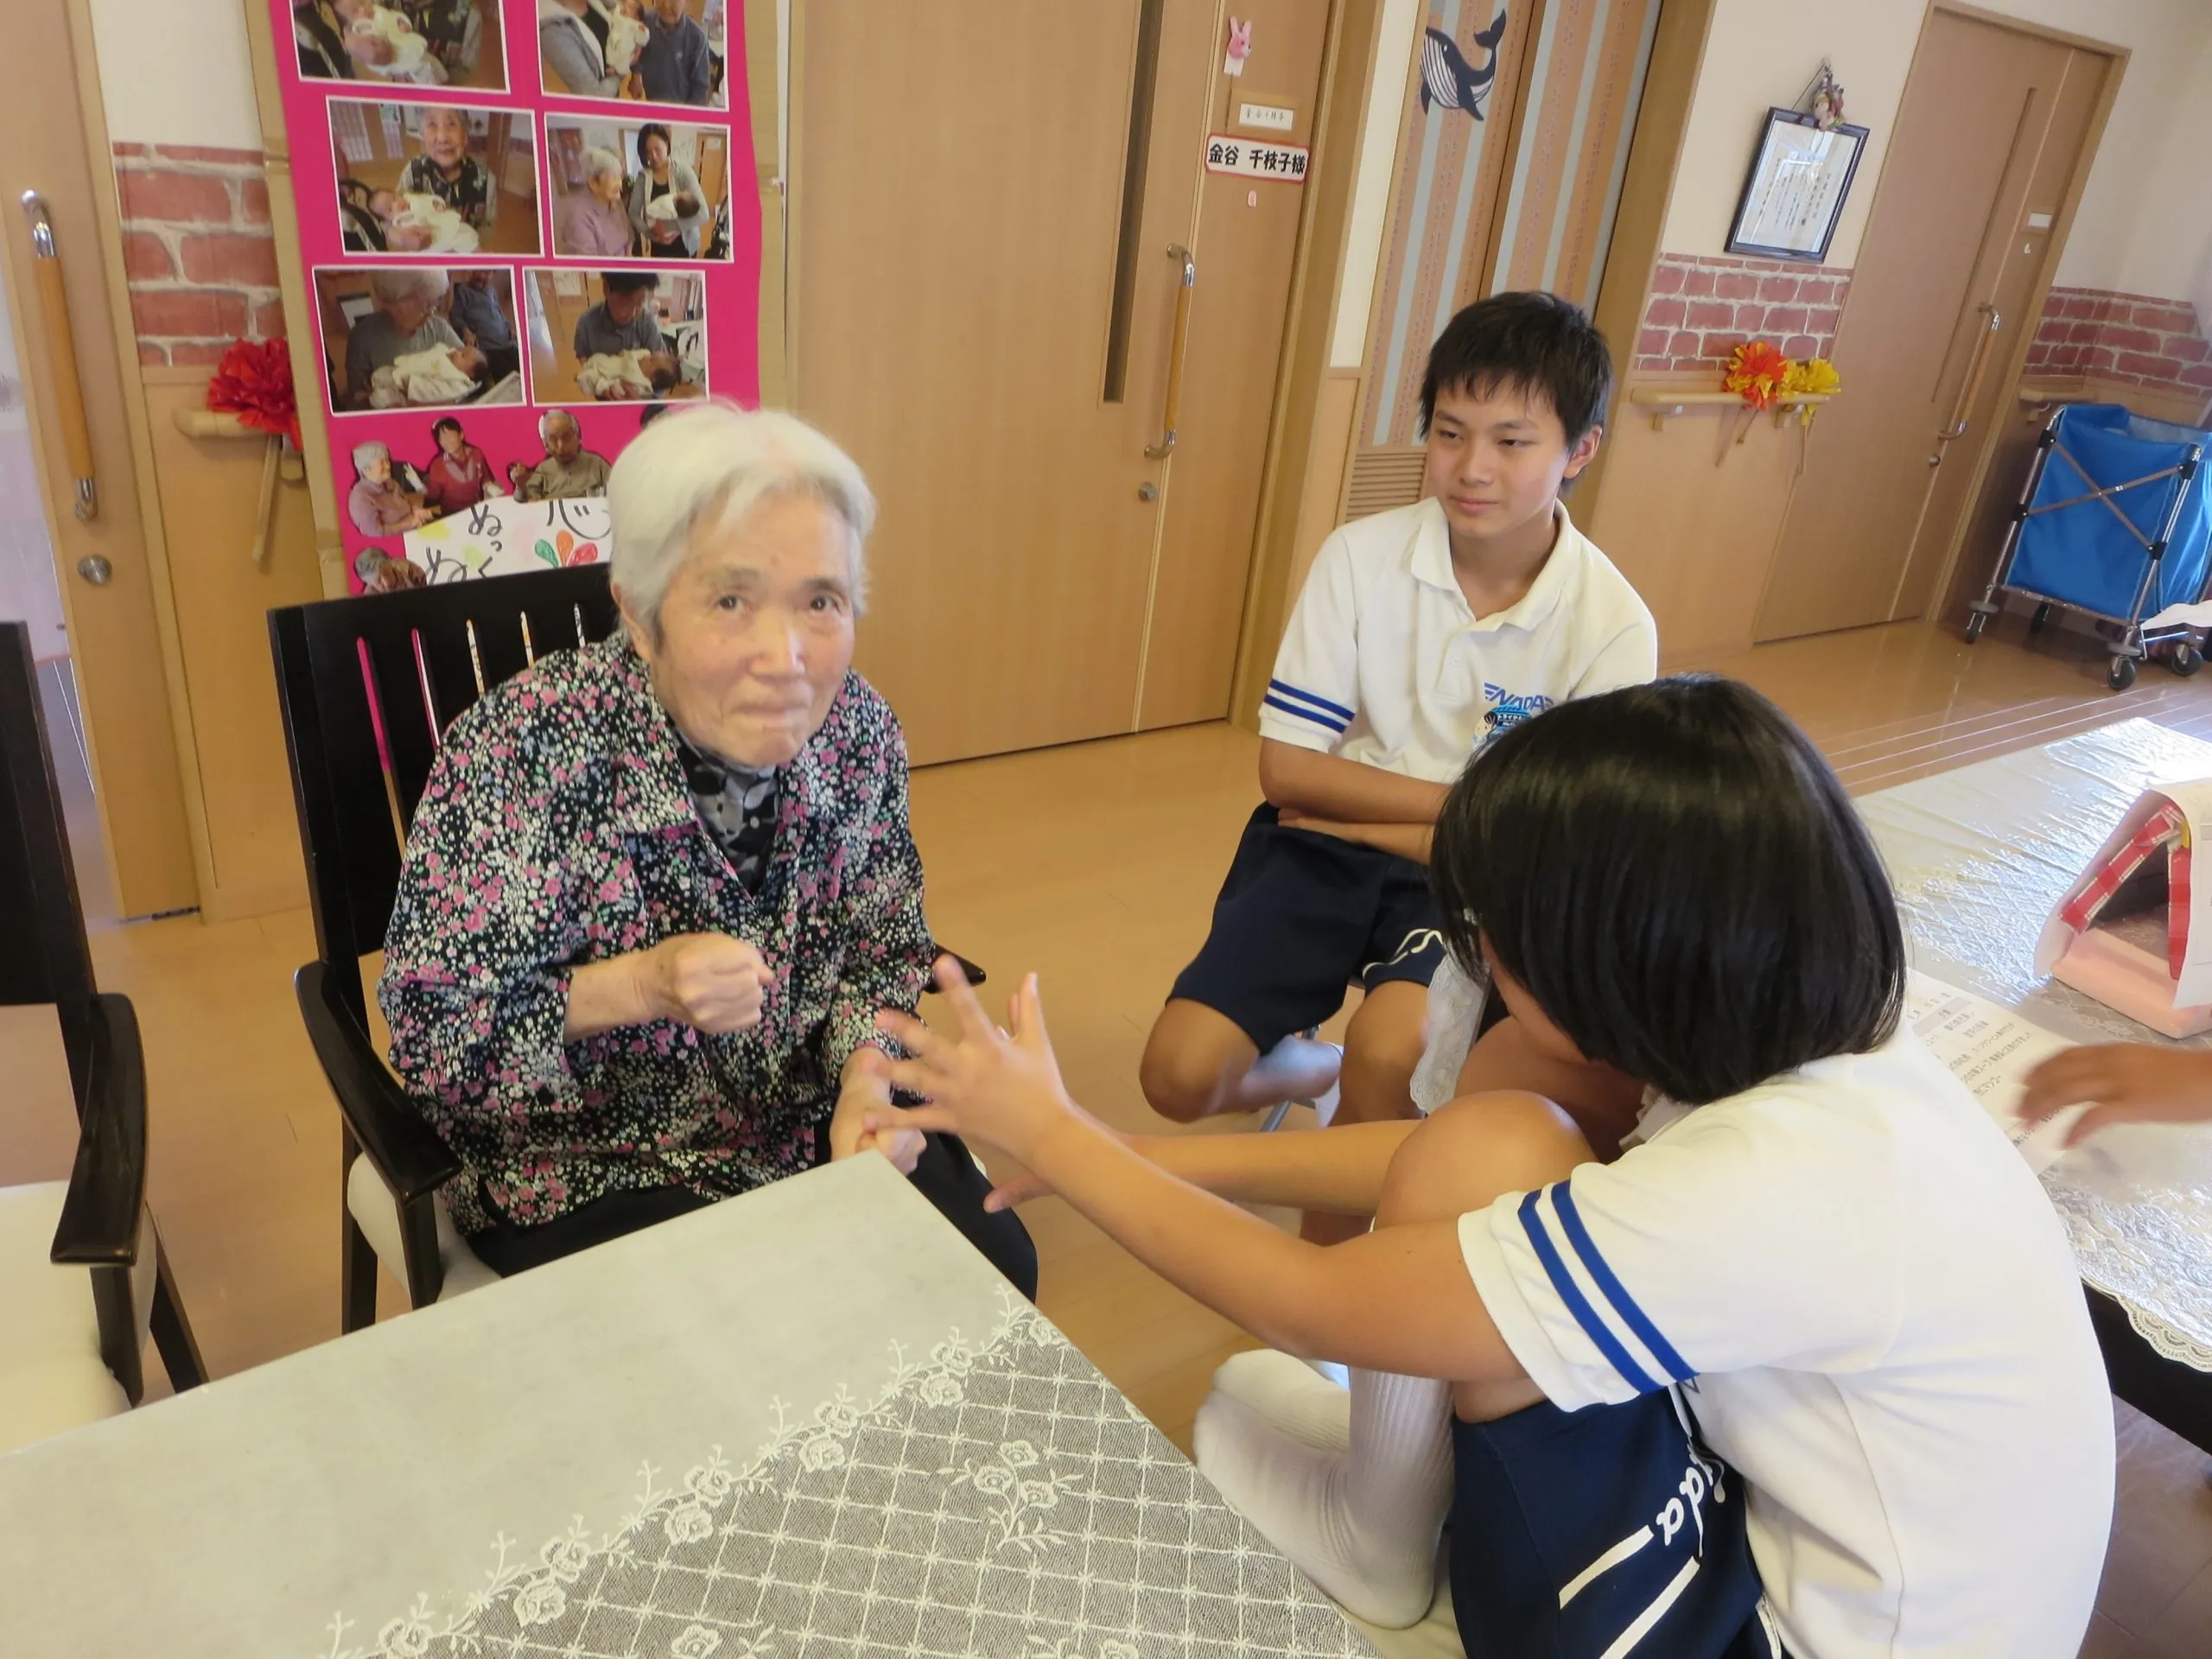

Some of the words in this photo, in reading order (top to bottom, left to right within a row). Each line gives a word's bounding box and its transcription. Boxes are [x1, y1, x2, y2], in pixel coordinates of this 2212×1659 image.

[1209, 143, 1239, 165] 金谷
[1249, 149, 1306, 174] 千枝子様
